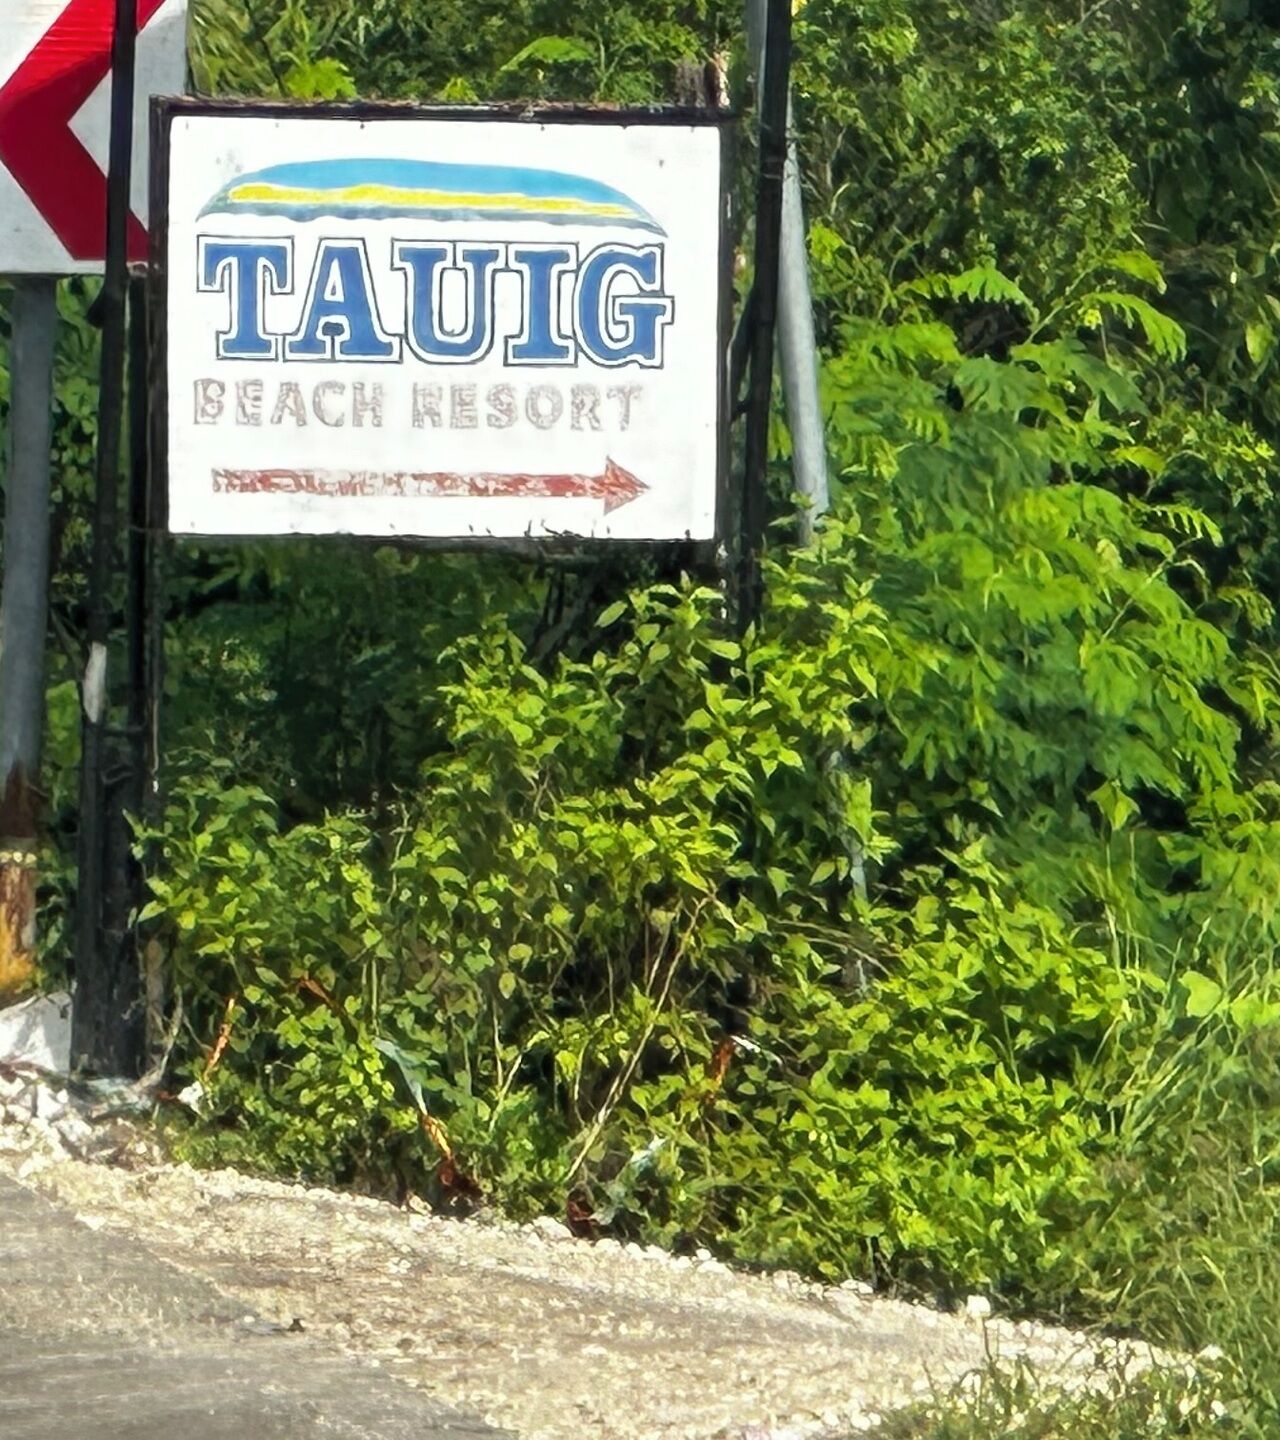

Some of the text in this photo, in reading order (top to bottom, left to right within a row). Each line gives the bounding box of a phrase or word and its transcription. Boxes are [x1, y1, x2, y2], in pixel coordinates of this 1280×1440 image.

[196, 234, 675, 369] TAUIG
[192, 377, 643, 432] BEACH RESORT
